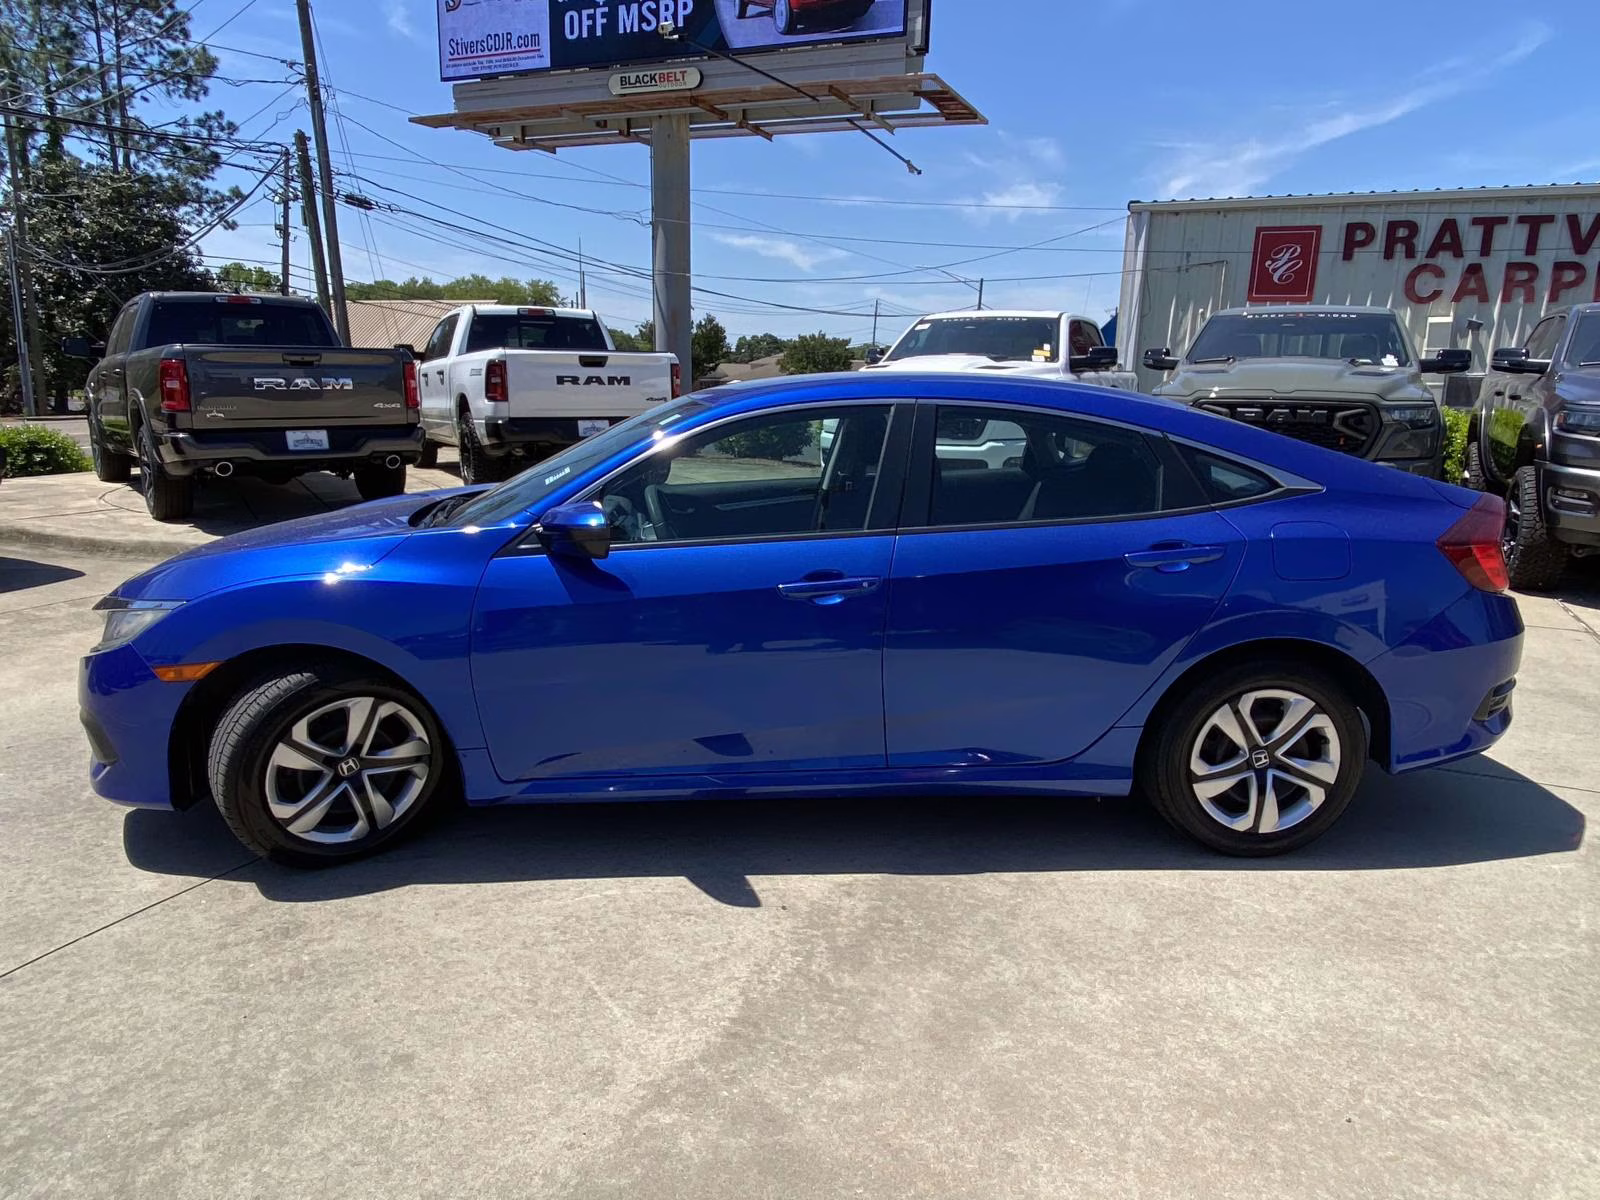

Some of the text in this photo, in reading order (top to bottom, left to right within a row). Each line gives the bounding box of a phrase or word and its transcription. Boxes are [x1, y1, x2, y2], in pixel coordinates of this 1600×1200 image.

[564, 0, 693, 40] OFF MSRP
[448, 32, 540, 56] StiversCDJR.com
[1342, 214, 1600, 261] PRATTV
[1405, 261, 1600, 304] CARP
[254, 377, 353, 390] RAM
[556, 375, 631, 386] RAM
